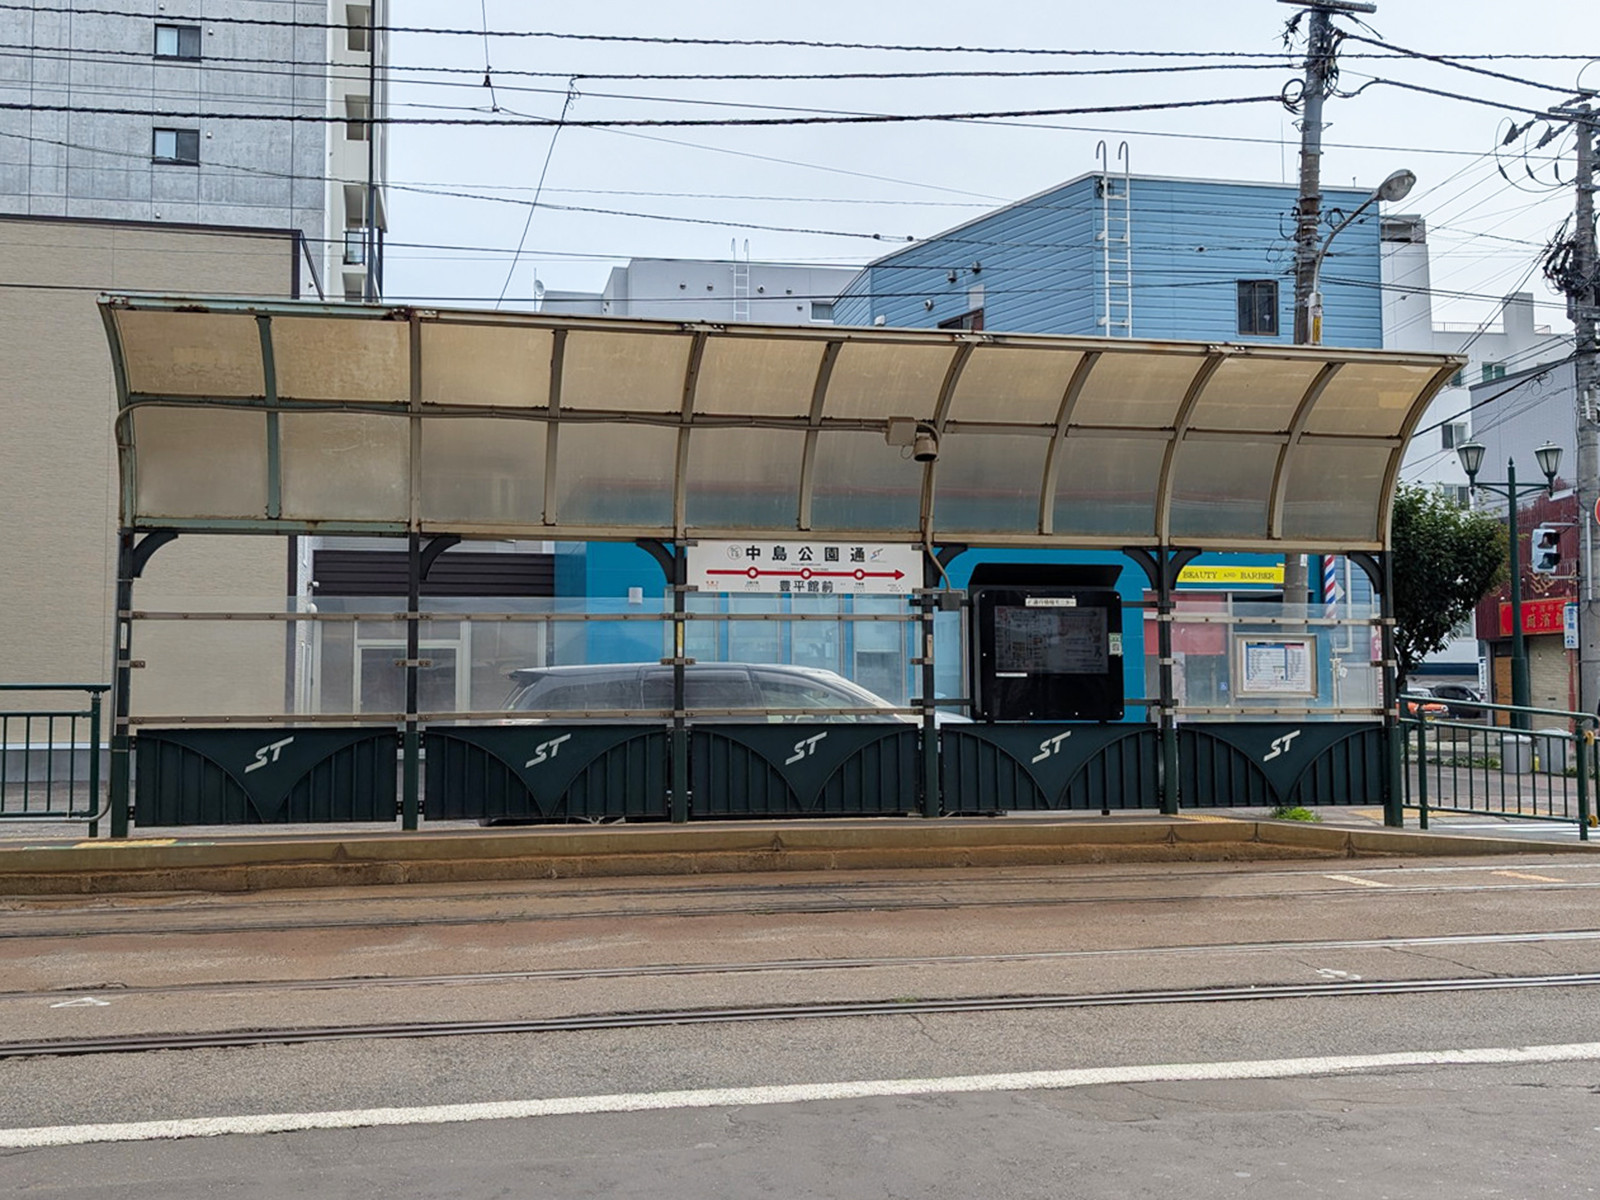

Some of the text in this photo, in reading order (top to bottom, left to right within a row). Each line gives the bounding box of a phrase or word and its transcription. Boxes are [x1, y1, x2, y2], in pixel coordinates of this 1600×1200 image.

[745, 545, 865, 562] 中島公園通
[780, 580, 833, 593] 豊平館前
[1182, 570, 1218, 580] BEAUTY
[1240, 571, 1275, 581] BARBER
[244, 736, 295, 774] ST
[524, 733, 571, 769] ST
[785, 731, 828, 766] ST
[1031, 730, 1072, 765] ST
[1263, 730, 1301, 763] ST
